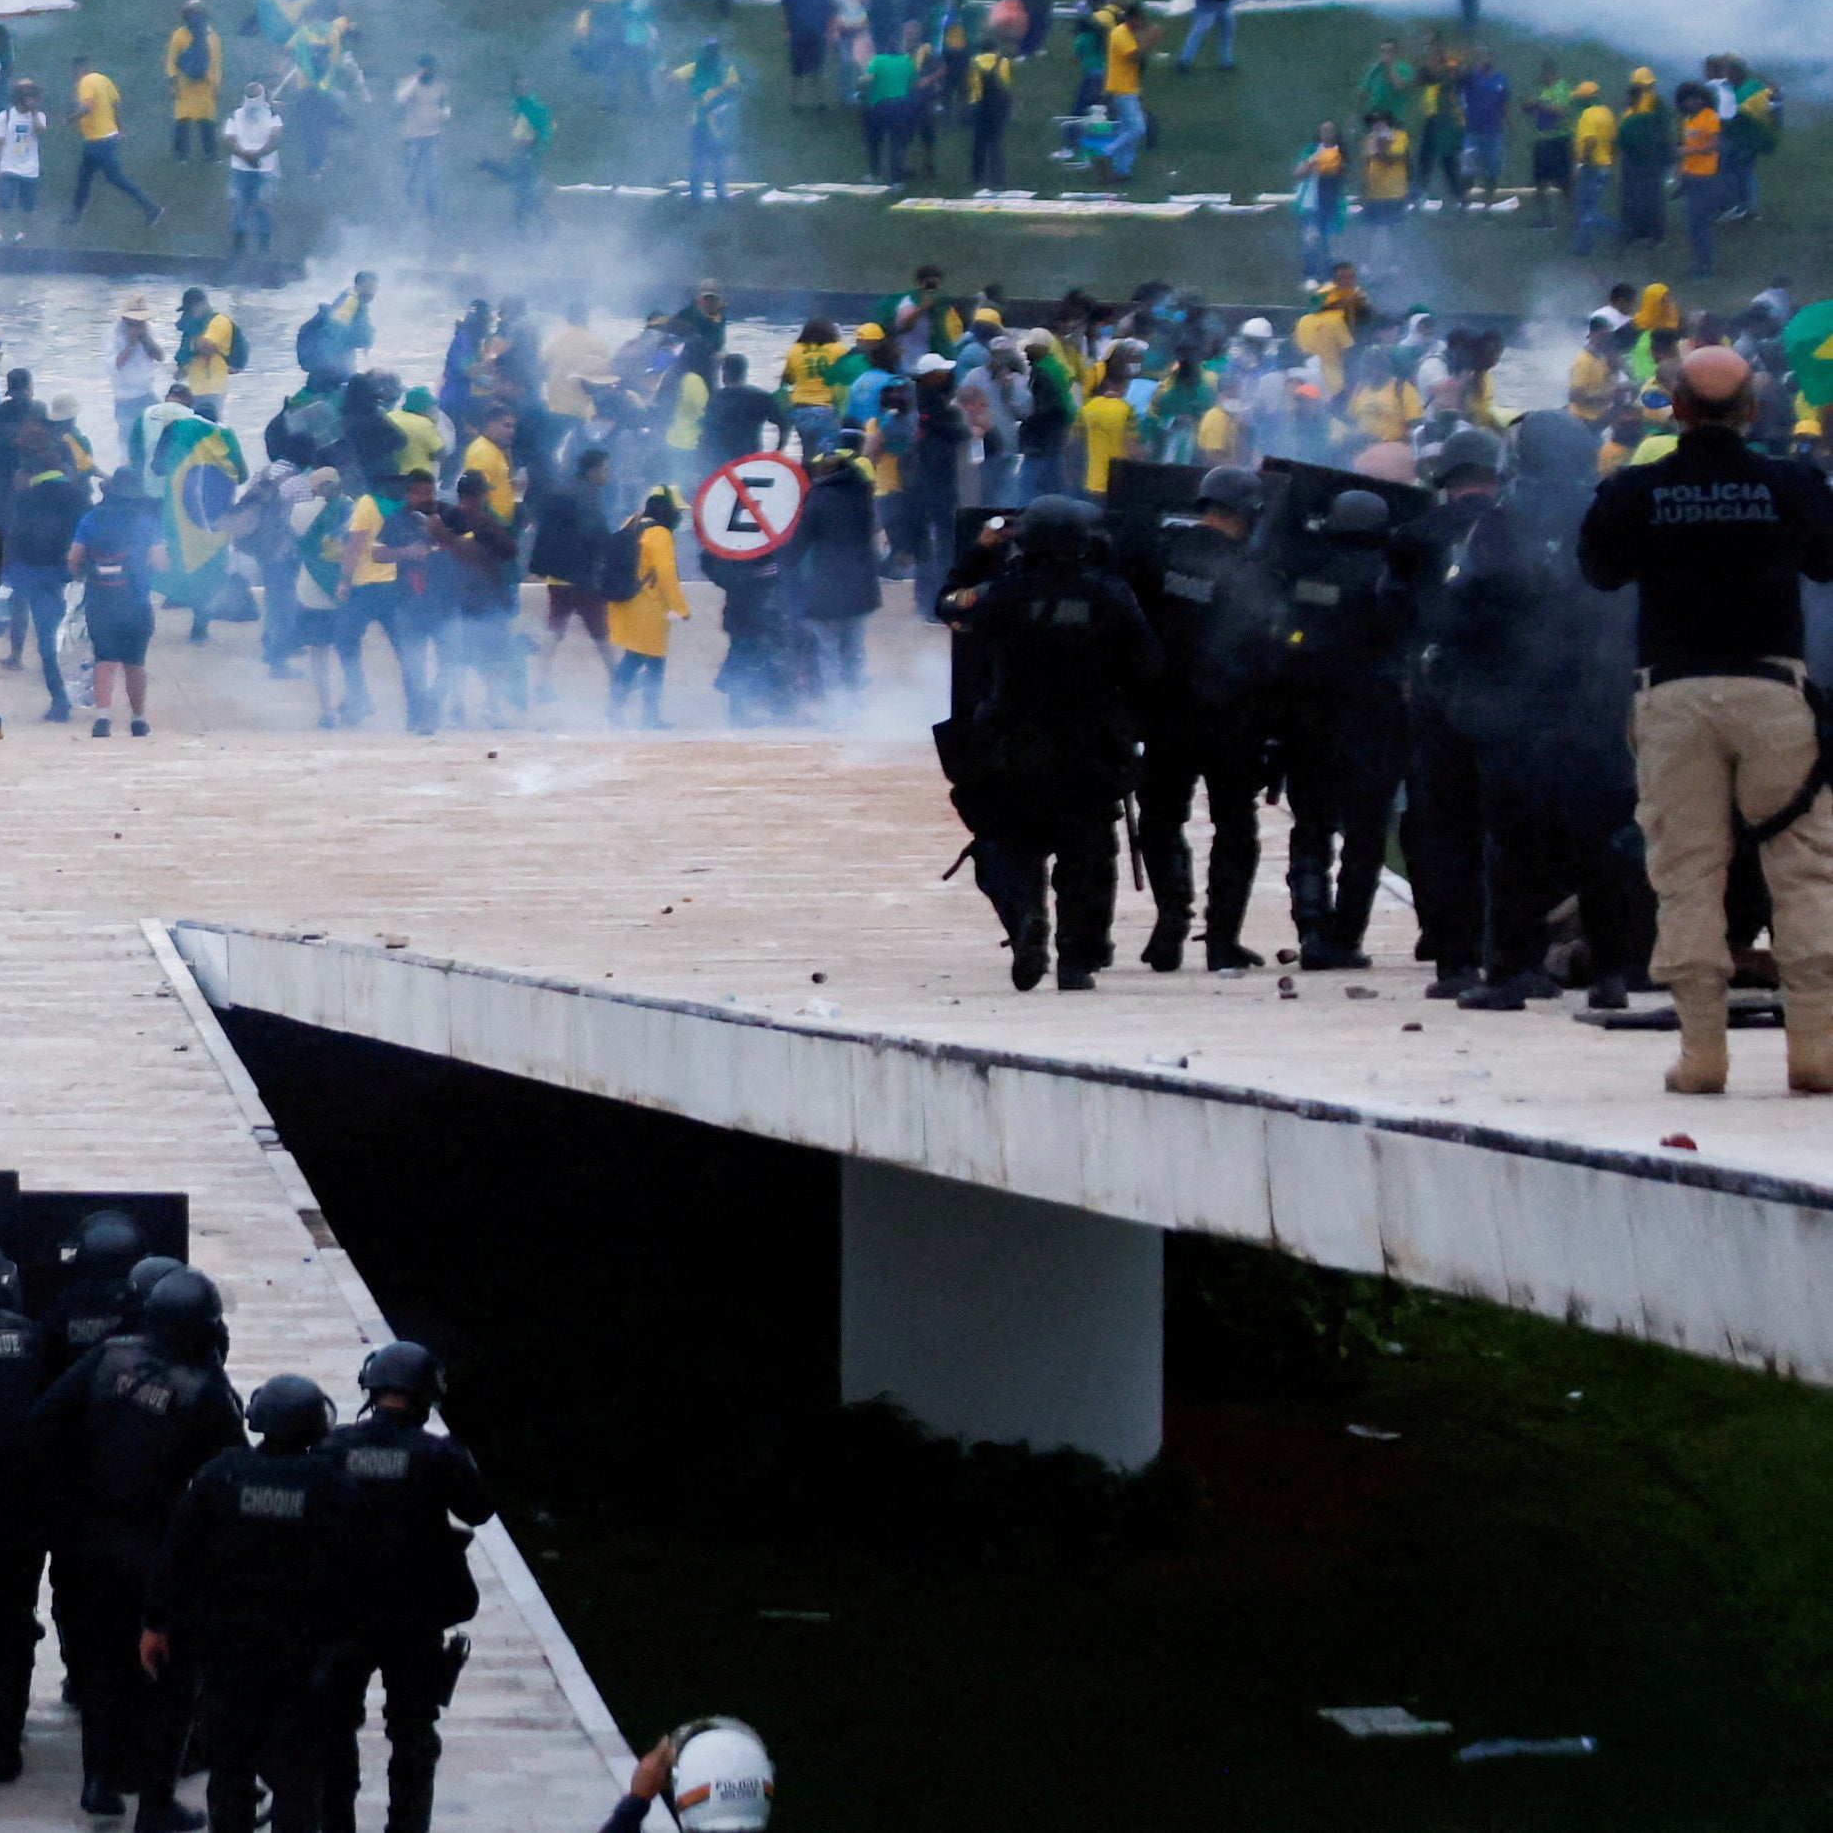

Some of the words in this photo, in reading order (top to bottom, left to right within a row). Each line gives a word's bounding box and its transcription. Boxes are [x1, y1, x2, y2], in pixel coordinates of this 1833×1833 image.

[726, 476, 775, 532] E
[1648, 502, 1780, 525] JUDICIAL
[240, 1485, 306, 1518] CHOQUE
